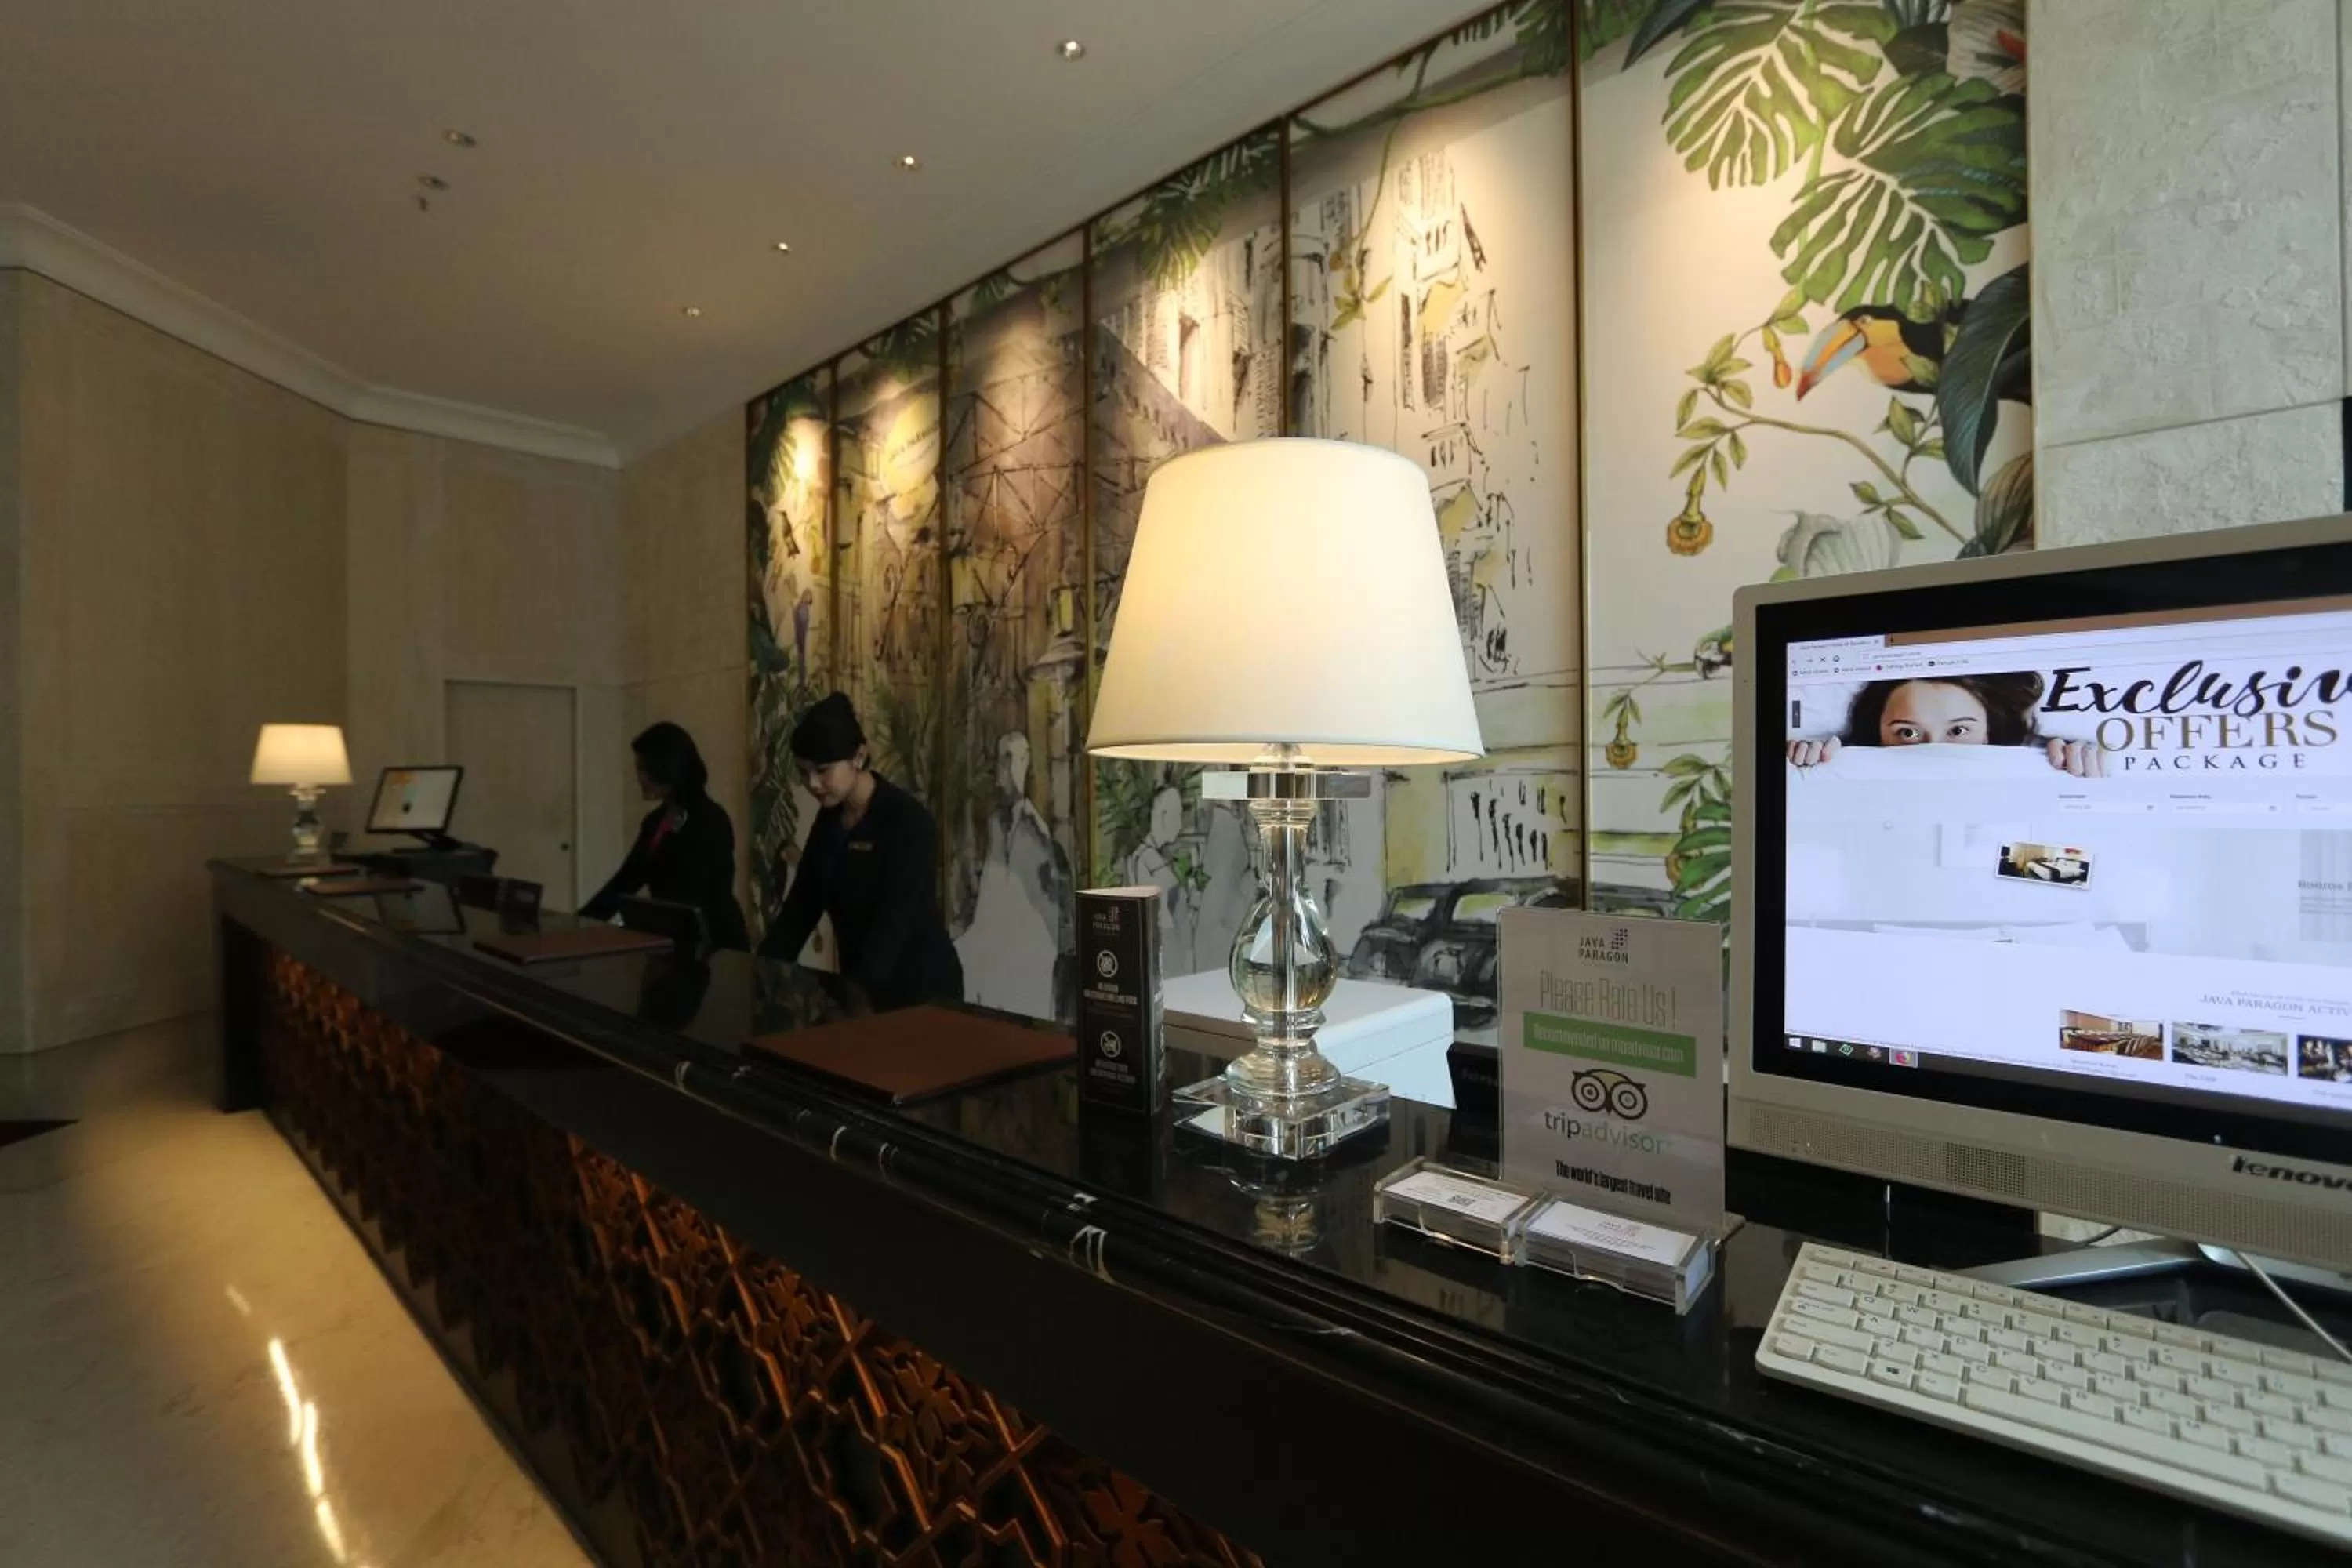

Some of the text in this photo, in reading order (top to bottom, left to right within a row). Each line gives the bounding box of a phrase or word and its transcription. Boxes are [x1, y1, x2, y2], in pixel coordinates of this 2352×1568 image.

[2040, 660, 2352, 717] Exclusiv
[2096, 710, 2339, 752] OFFERS
[2124, 753, 2307, 771] PACKAGE
[1578, 948, 1629, 964] PARAGON
[1580, 936, 1605, 948] JAVA
[1540, 969, 1594, 1017] Please
[1599, 978, 1638, 1023] Rate
[2201, 993, 2234, 1007] JAVA
[2237, 997, 2304, 1013] PARAGON
[2307, 1005, 2352, 1017] ACTIV
[1544, 1110, 1664, 1155] tripadvisor
